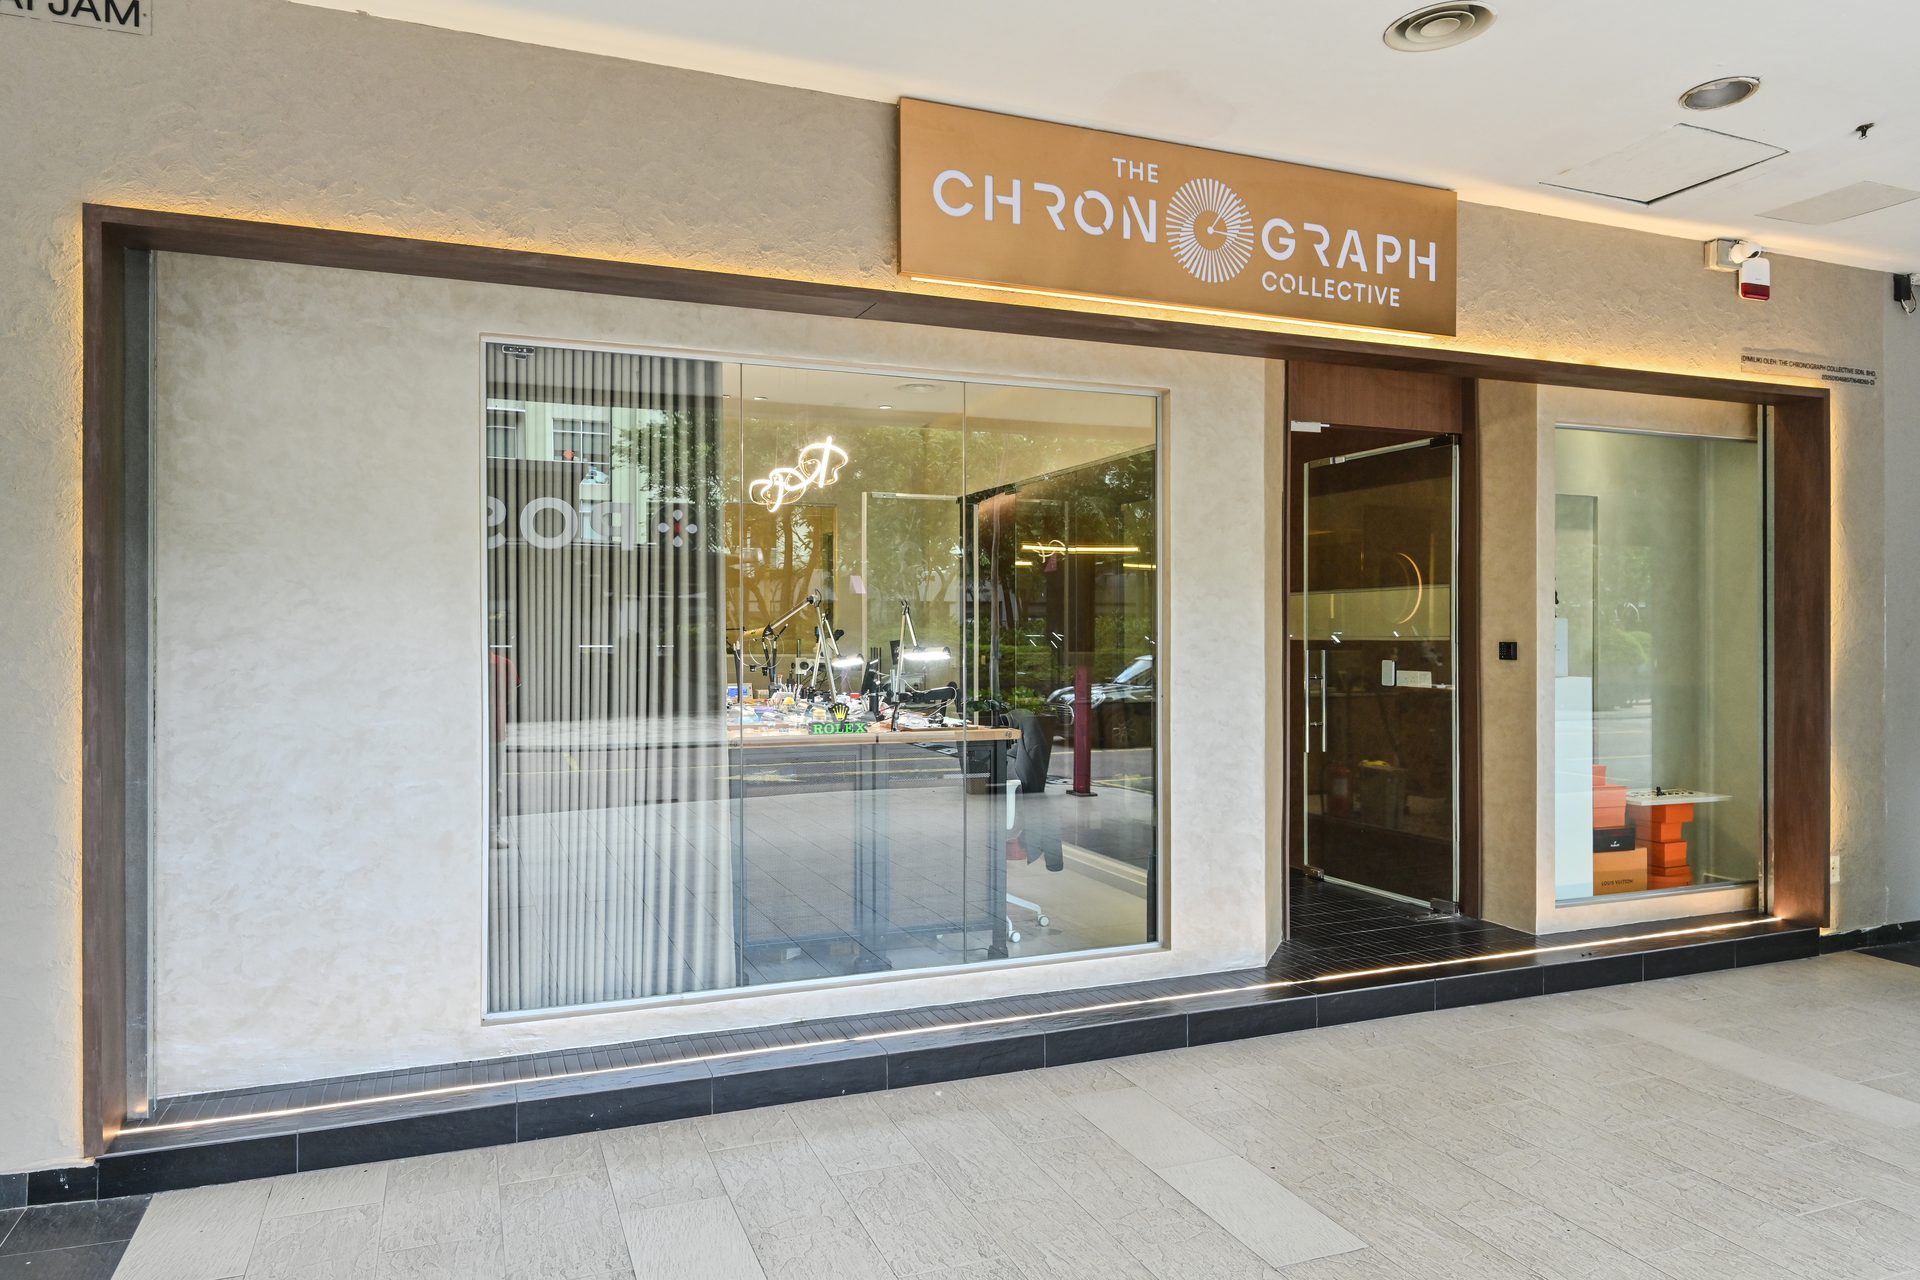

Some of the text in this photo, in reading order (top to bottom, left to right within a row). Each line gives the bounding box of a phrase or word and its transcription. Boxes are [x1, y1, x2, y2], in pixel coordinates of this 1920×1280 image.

[48, 0, 140, 27] JAM
[1112, 157, 1159, 184] THE
[1261, 270, 1400, 308] COLLECTIVE
[1789, 361, 1825, 370] CHRONOGRAPH
[1826, 365, 1854, 374] COLLECTIVE
[812, 722, 867, 735] ROLEX
